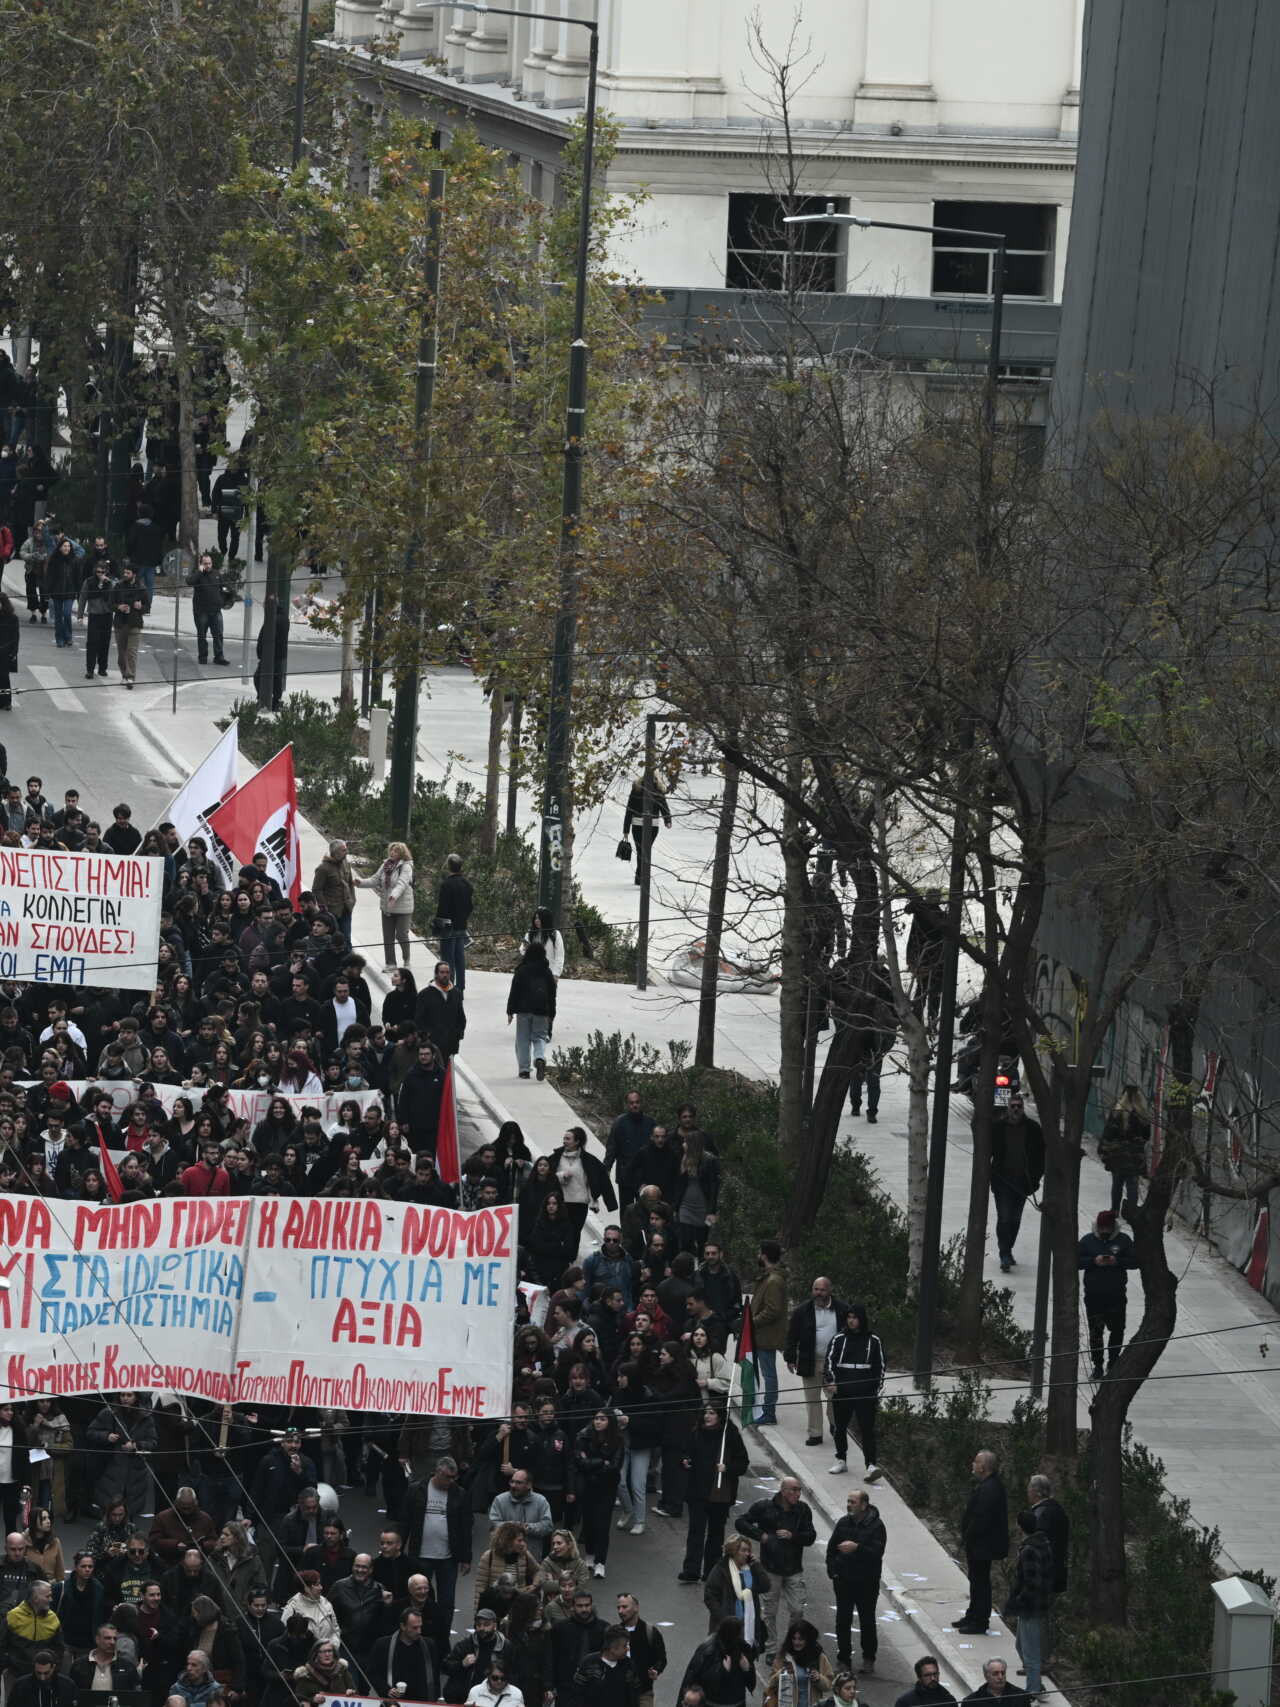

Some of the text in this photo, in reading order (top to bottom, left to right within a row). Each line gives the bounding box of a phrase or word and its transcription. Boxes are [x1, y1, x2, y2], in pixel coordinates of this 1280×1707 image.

[23, 894, 122, 926] ΚΟΛΛΕΓΙΑ!
[31, 922, 136, 954] ΣΠΟΥΔΕΣ!
[35, 954, 86, 985] ΕΜΠ
[75, 1204, 160, 1250] ΜΗΝ
[172, 1199, 249, 1247] ΓΙΝΕΙ
[258, 1200, 279, 1249] Η
[282, 1202, 383, 1253] ΑΔΙΚΙΑ
[401, 1205, 514, 1259] ΝΟΜΟΣ
[41, 1253, 109, 1299] ΣΤΑ
[122, 1249, 245, 1301] ΙΔΙΩΤΙΚΑ
[310, 1256, 443, 1305] ΠΤΥΧΙΑ
[462, 1262, 503, 1307] ΜΕ
[39, 1294, 423, 1348] ΠΑΝΕΠΙΣΤΗΜΙΑ ΑΞΙΑ
